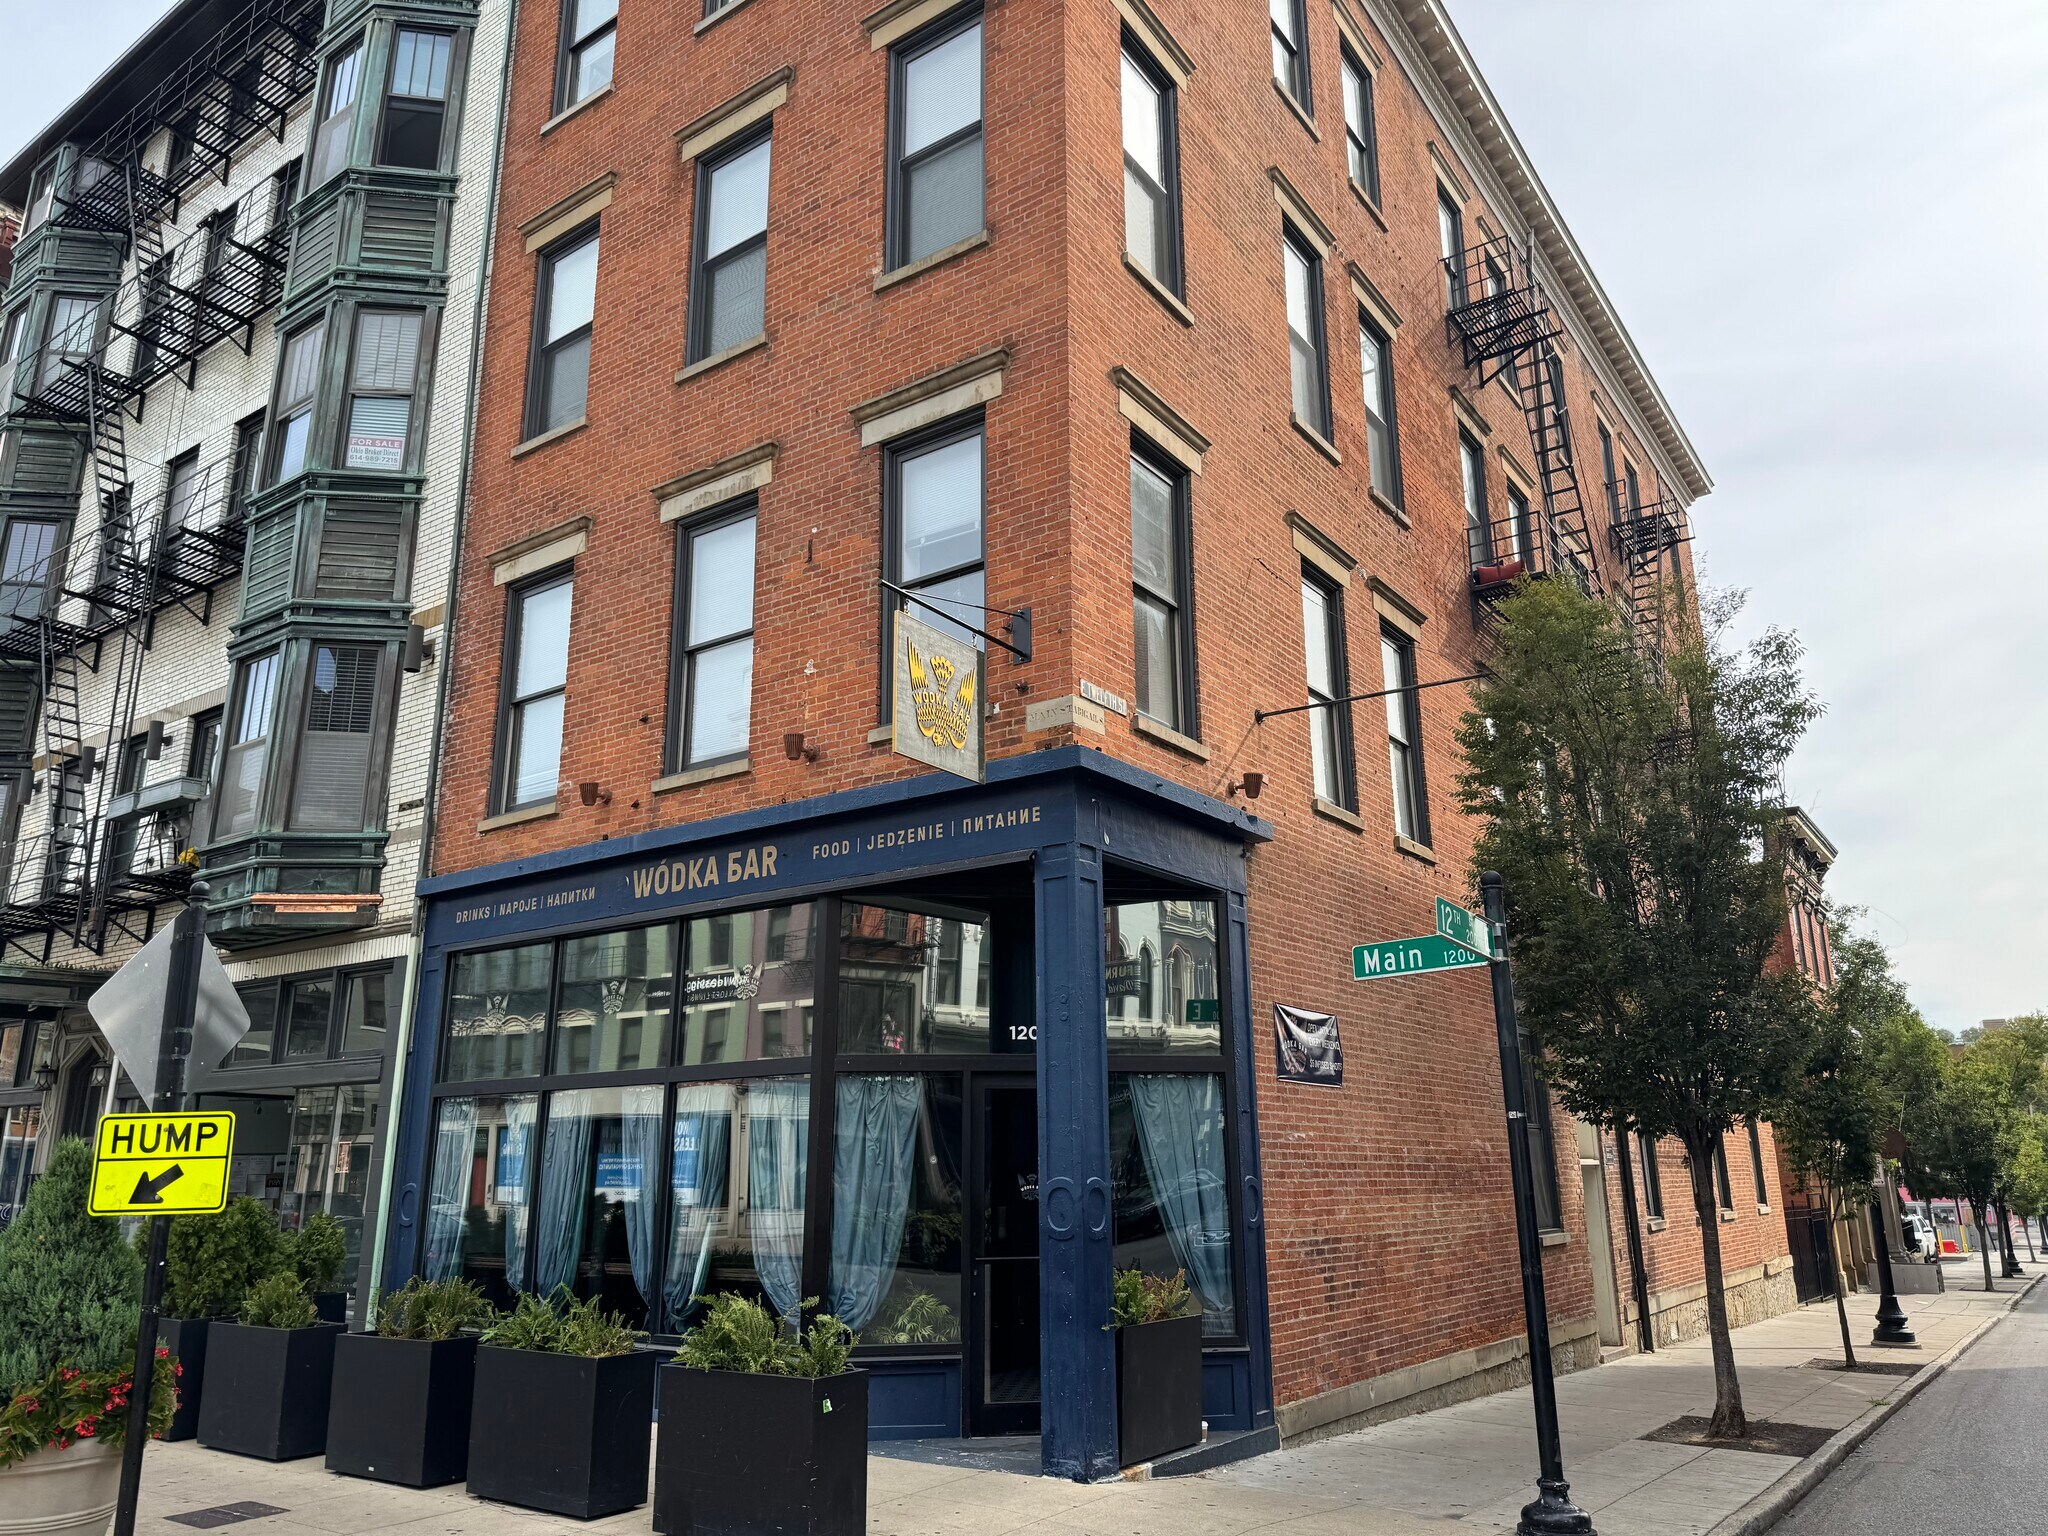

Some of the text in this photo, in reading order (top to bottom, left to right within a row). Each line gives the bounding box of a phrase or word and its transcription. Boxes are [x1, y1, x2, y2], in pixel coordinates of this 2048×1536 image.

[352, 438, 400, 448] FOR SALE
[813, 806, 1041, 859] FOOD JEDZENIE ПИТАНИЕ
[633, 859, 720, 899] WÓDKA
[456, 886, 596, 924] DRINKS NAPOJE НАПИТКИ
[1363, 944, 1476, 974] Main 1200
[111, 1122, 218, 1154] HUMP
